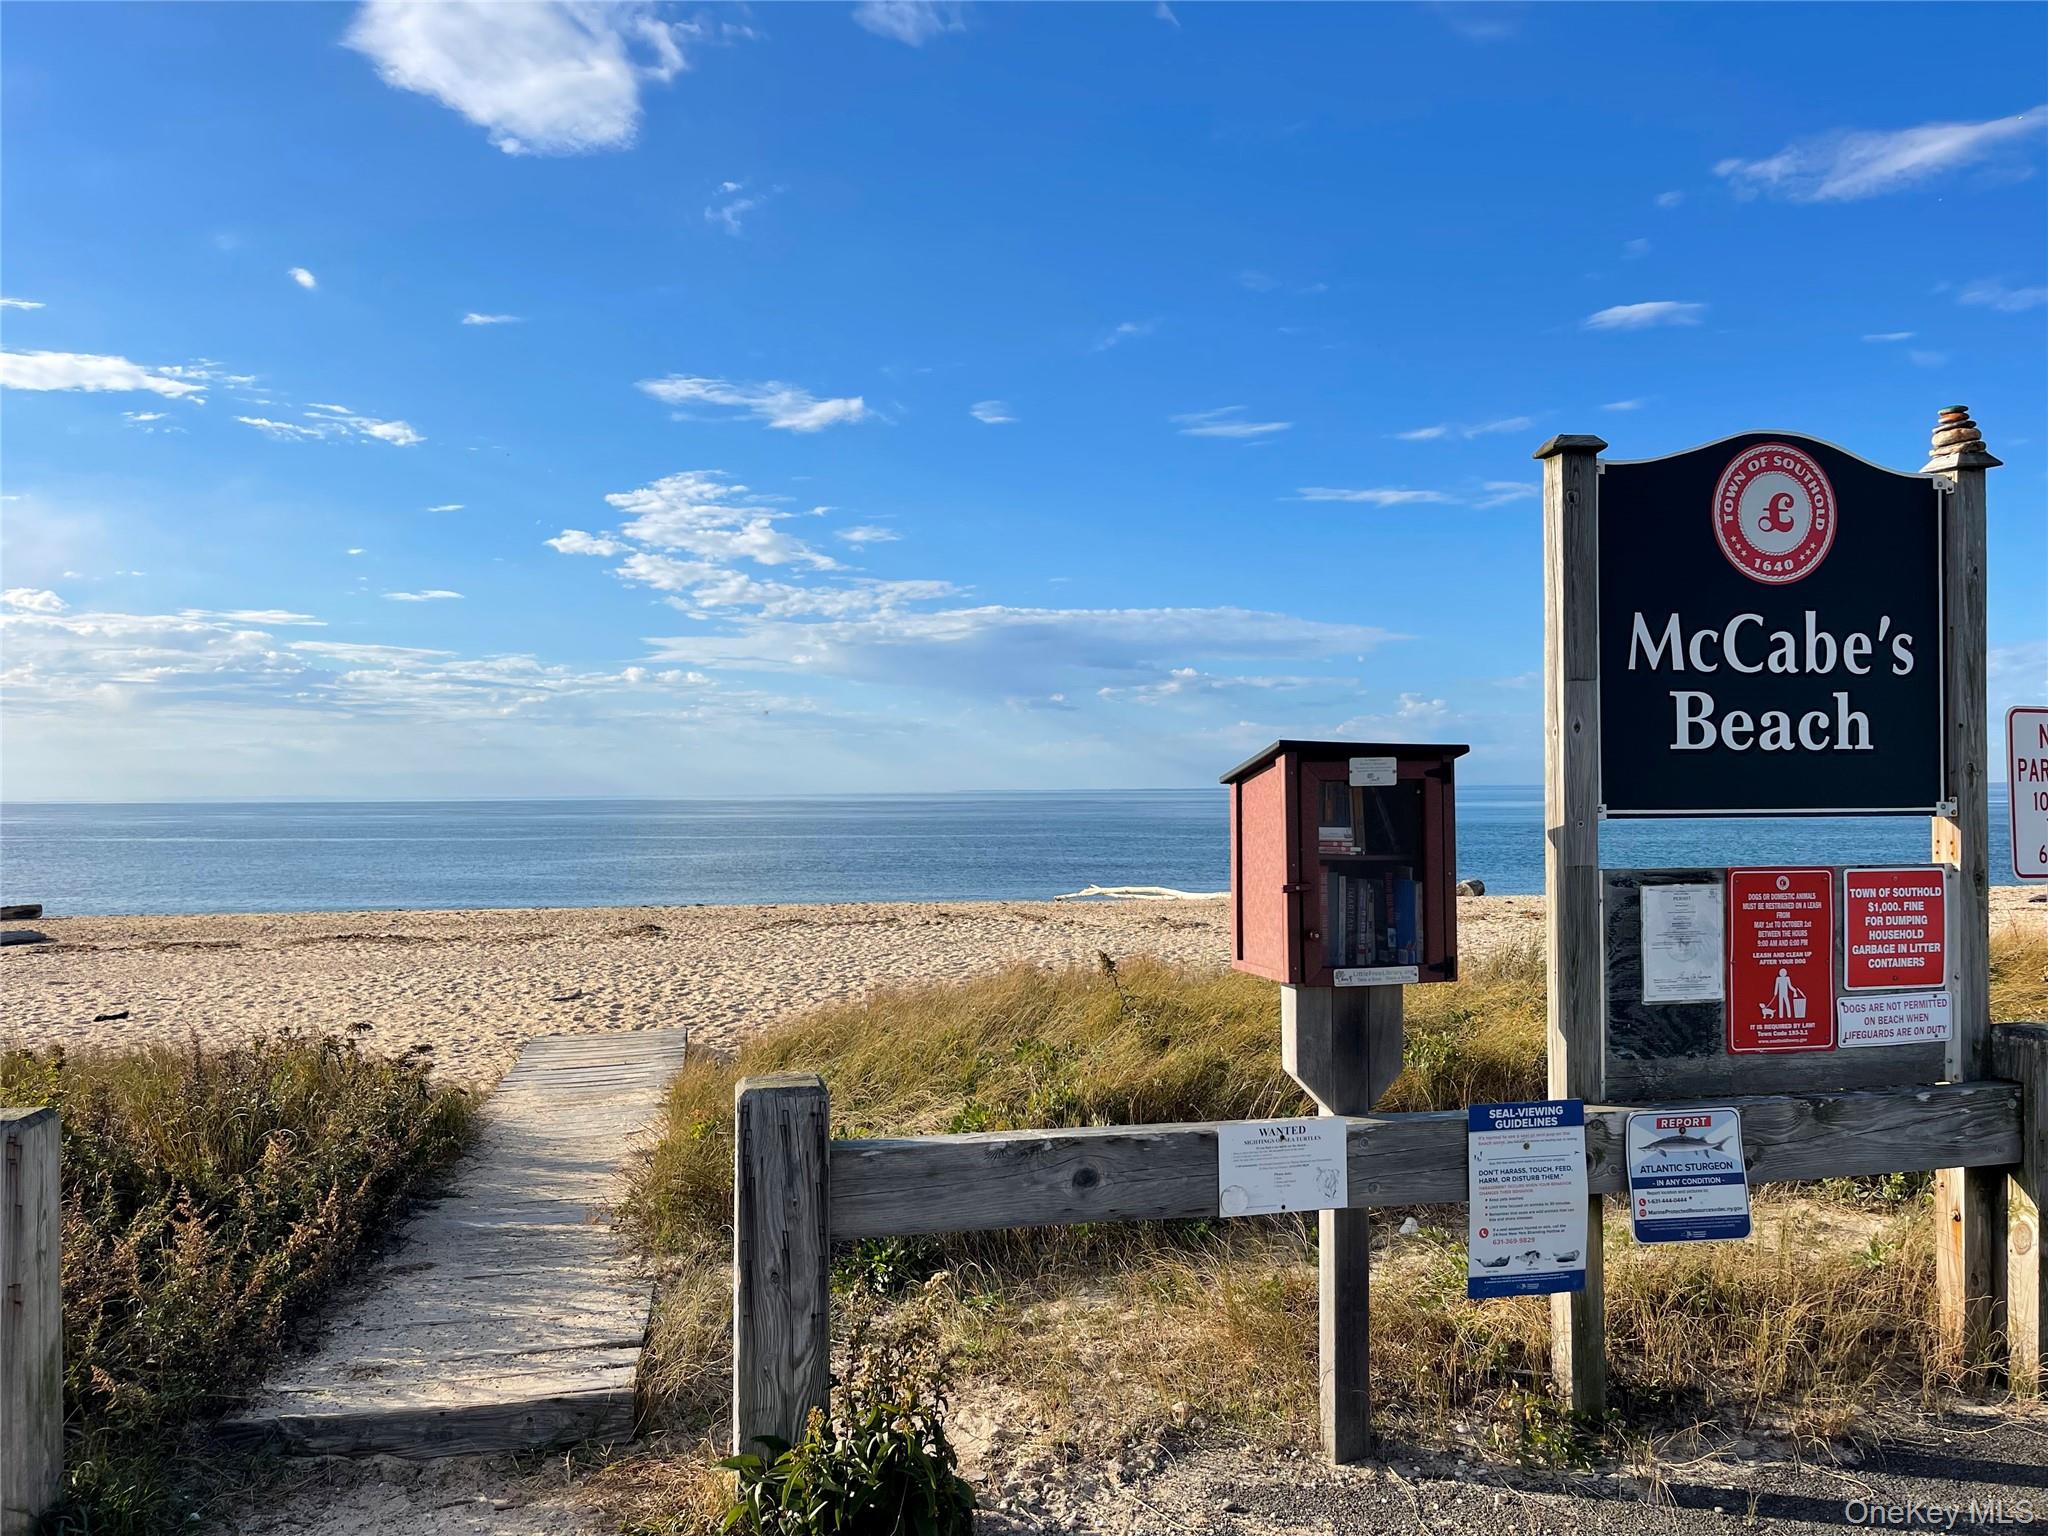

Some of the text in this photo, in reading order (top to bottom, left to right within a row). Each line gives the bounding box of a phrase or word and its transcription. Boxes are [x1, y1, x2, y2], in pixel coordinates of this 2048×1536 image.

[1723, 456, 1825, 531] TOWN OF SOUTHOLD
[1754, 558, 1794, 571] 1640
[1627, 610, 1915, 676] McCabe's
[1669, 691, 1874, 751] Beach
[1850, 887, 1942, 898] TOWN OF SOUTHOLD
[1868, 901, 1924, 913] $1,000. FINE
[1865, 915, 1928, 926] FOR DUMPING
[1869, 930, 1924, 940] HOUSEHOLD
[1852, 943, 1941, 955] GARBAGE IN LITTER
[1868, 957, 1925, 968] CONTAINERS
[1844, 998, 1948, 1014] DOGS ARE NOT PERMITTED
[1864, 1013, 1929, 1026] ON BEACH WHEN
[1844, 1025, 1948, 1041] LIFEGUARDS ARE ON DUTY
[1489, 1106, 1564, 1119] SEAL-VIEWING
[1495, 1117, 1558, 1129] GUIDELINES
[1661, 1117, 1706, 1128] REPORT
[1259, 1126, 1306, 1137] WANTED
[1640, 1161, 1734, 1174] ATLANTIC STURGEON
[1682, 1177, 1721, 1185] CONDITION
